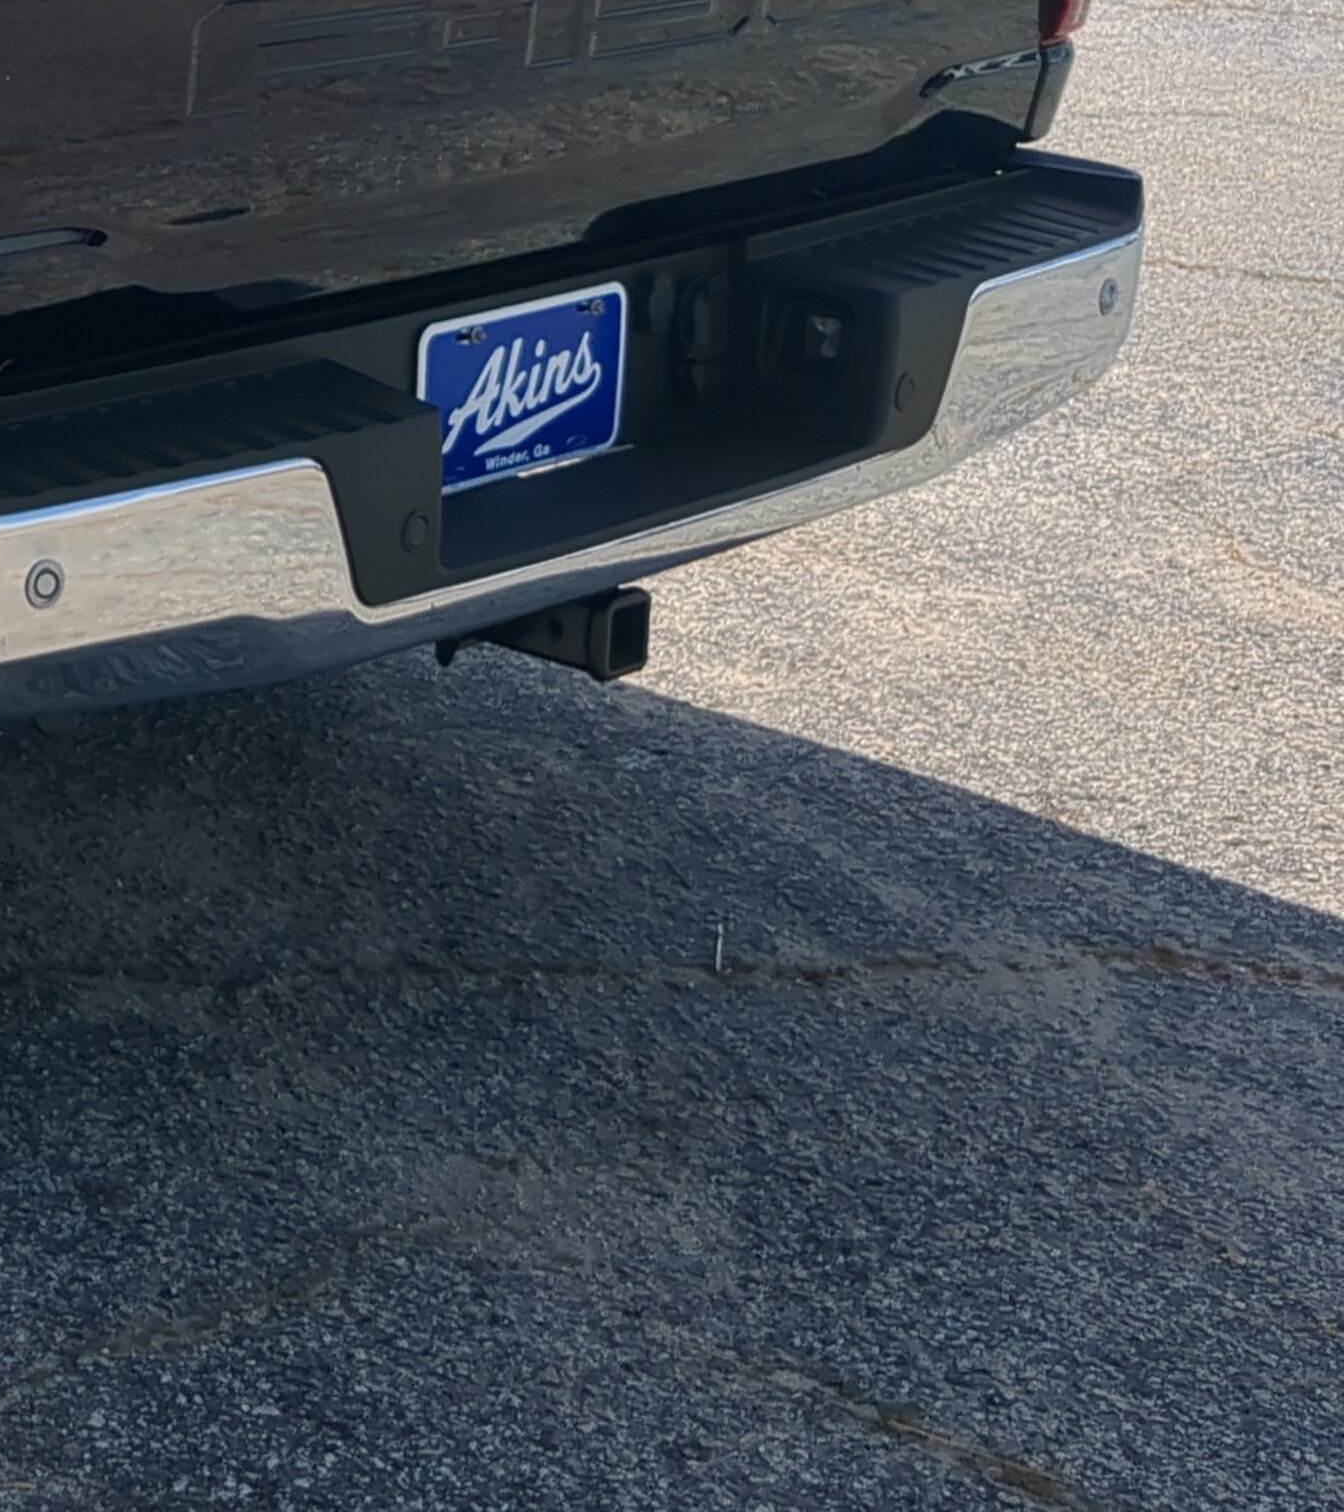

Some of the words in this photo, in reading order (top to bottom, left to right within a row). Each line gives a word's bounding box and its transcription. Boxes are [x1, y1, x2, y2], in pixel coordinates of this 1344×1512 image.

[442, 331, 602, 456] Akins
[485, 448, 530, 471] Winder,
[533, 443, 551, 459] Ga
